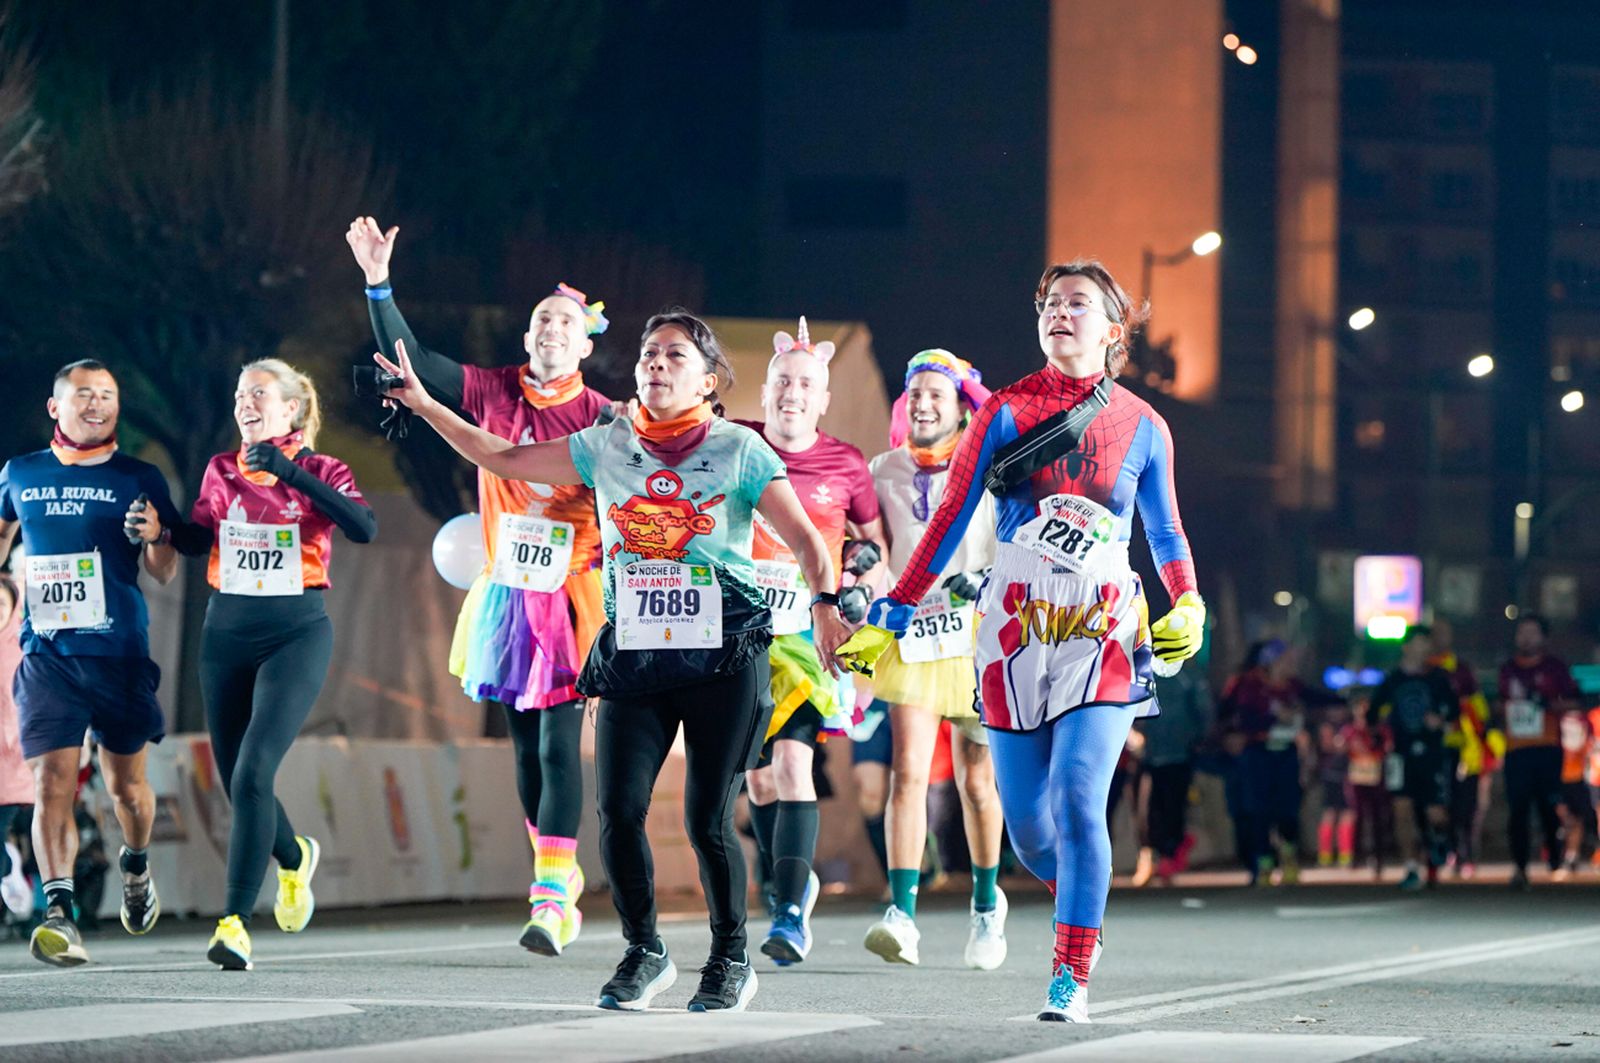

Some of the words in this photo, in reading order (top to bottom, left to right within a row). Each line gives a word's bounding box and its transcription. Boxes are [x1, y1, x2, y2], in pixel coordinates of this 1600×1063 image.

[21, 487, 58, 502] CAJA
[61, 487, 117, 503] RURAL
[45, 501, 86, 516] JAÉN
[229, 539, 243, 547] SAN
[511, 541, 552, 567] 7078
[236, 549, 284, 571] 2072
[639, 566, 668, 576] NOCHE
[669, 566, 682, 575] DE
[42, 580, 87, 604] 2073
[627, 577, 648, 589] SAN
[649, 575, 682, 588] ANTÓN
[636, 588, 701, 617] 7689
[757, 586, 797, 610] 077
[912, 611, 963, 639] 3525
